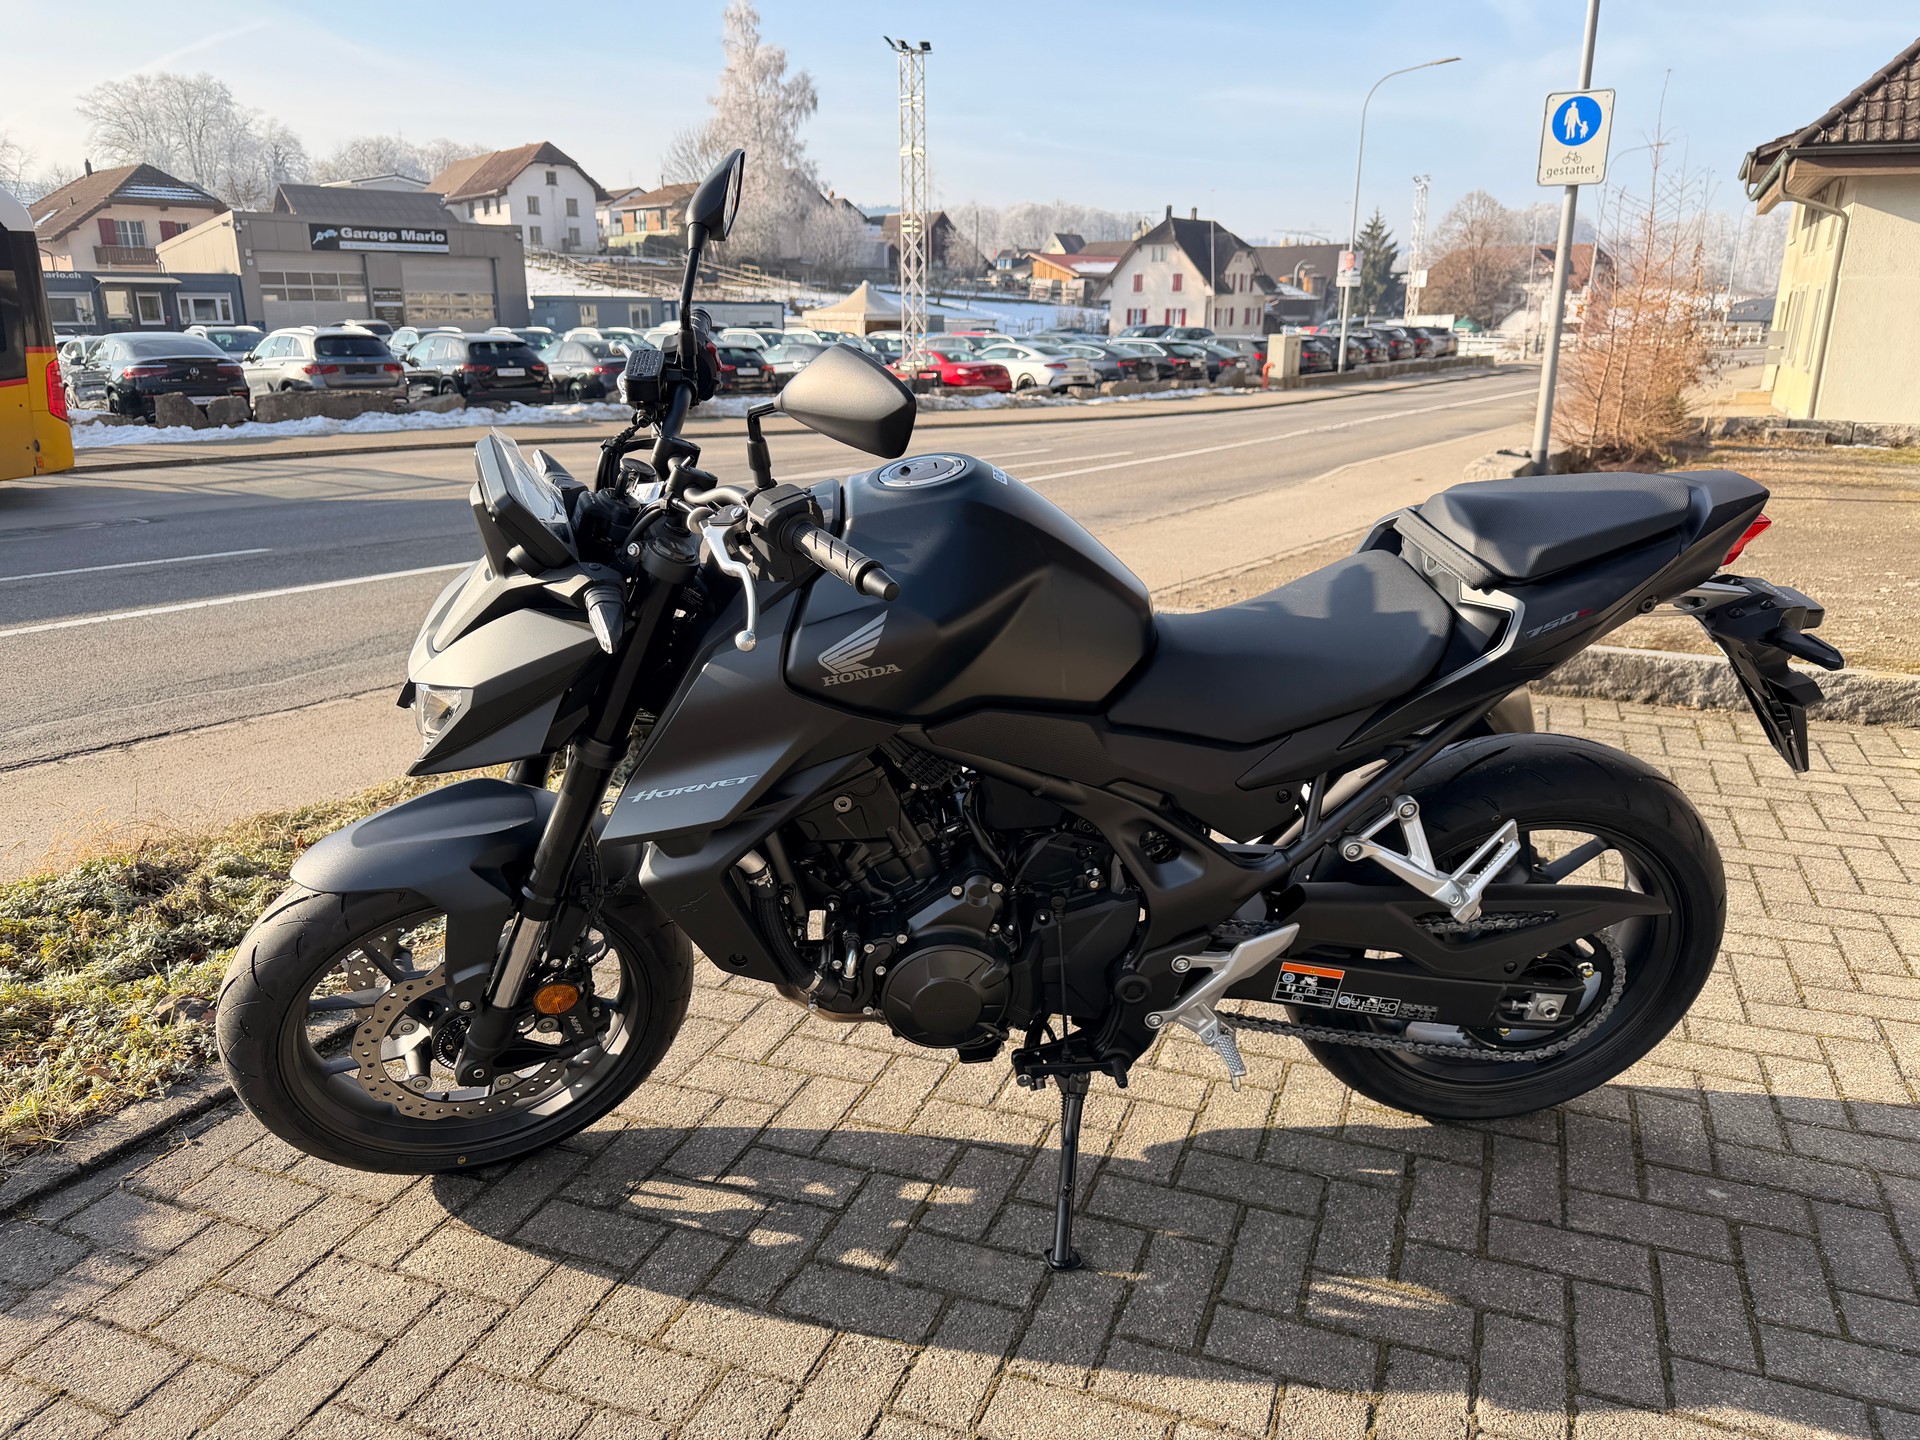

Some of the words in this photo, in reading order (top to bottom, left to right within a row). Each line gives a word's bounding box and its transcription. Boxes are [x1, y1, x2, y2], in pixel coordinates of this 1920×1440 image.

[1546, 165, 1595, 178] gestattet
[340, 227, 397, 242] Garage
[401, 229, 445, 242] Mario
[1526, 611, 1579, 639] 750
[822, 663, 902, 687] HONDA
[627, 774, 758, 803] HORNET
